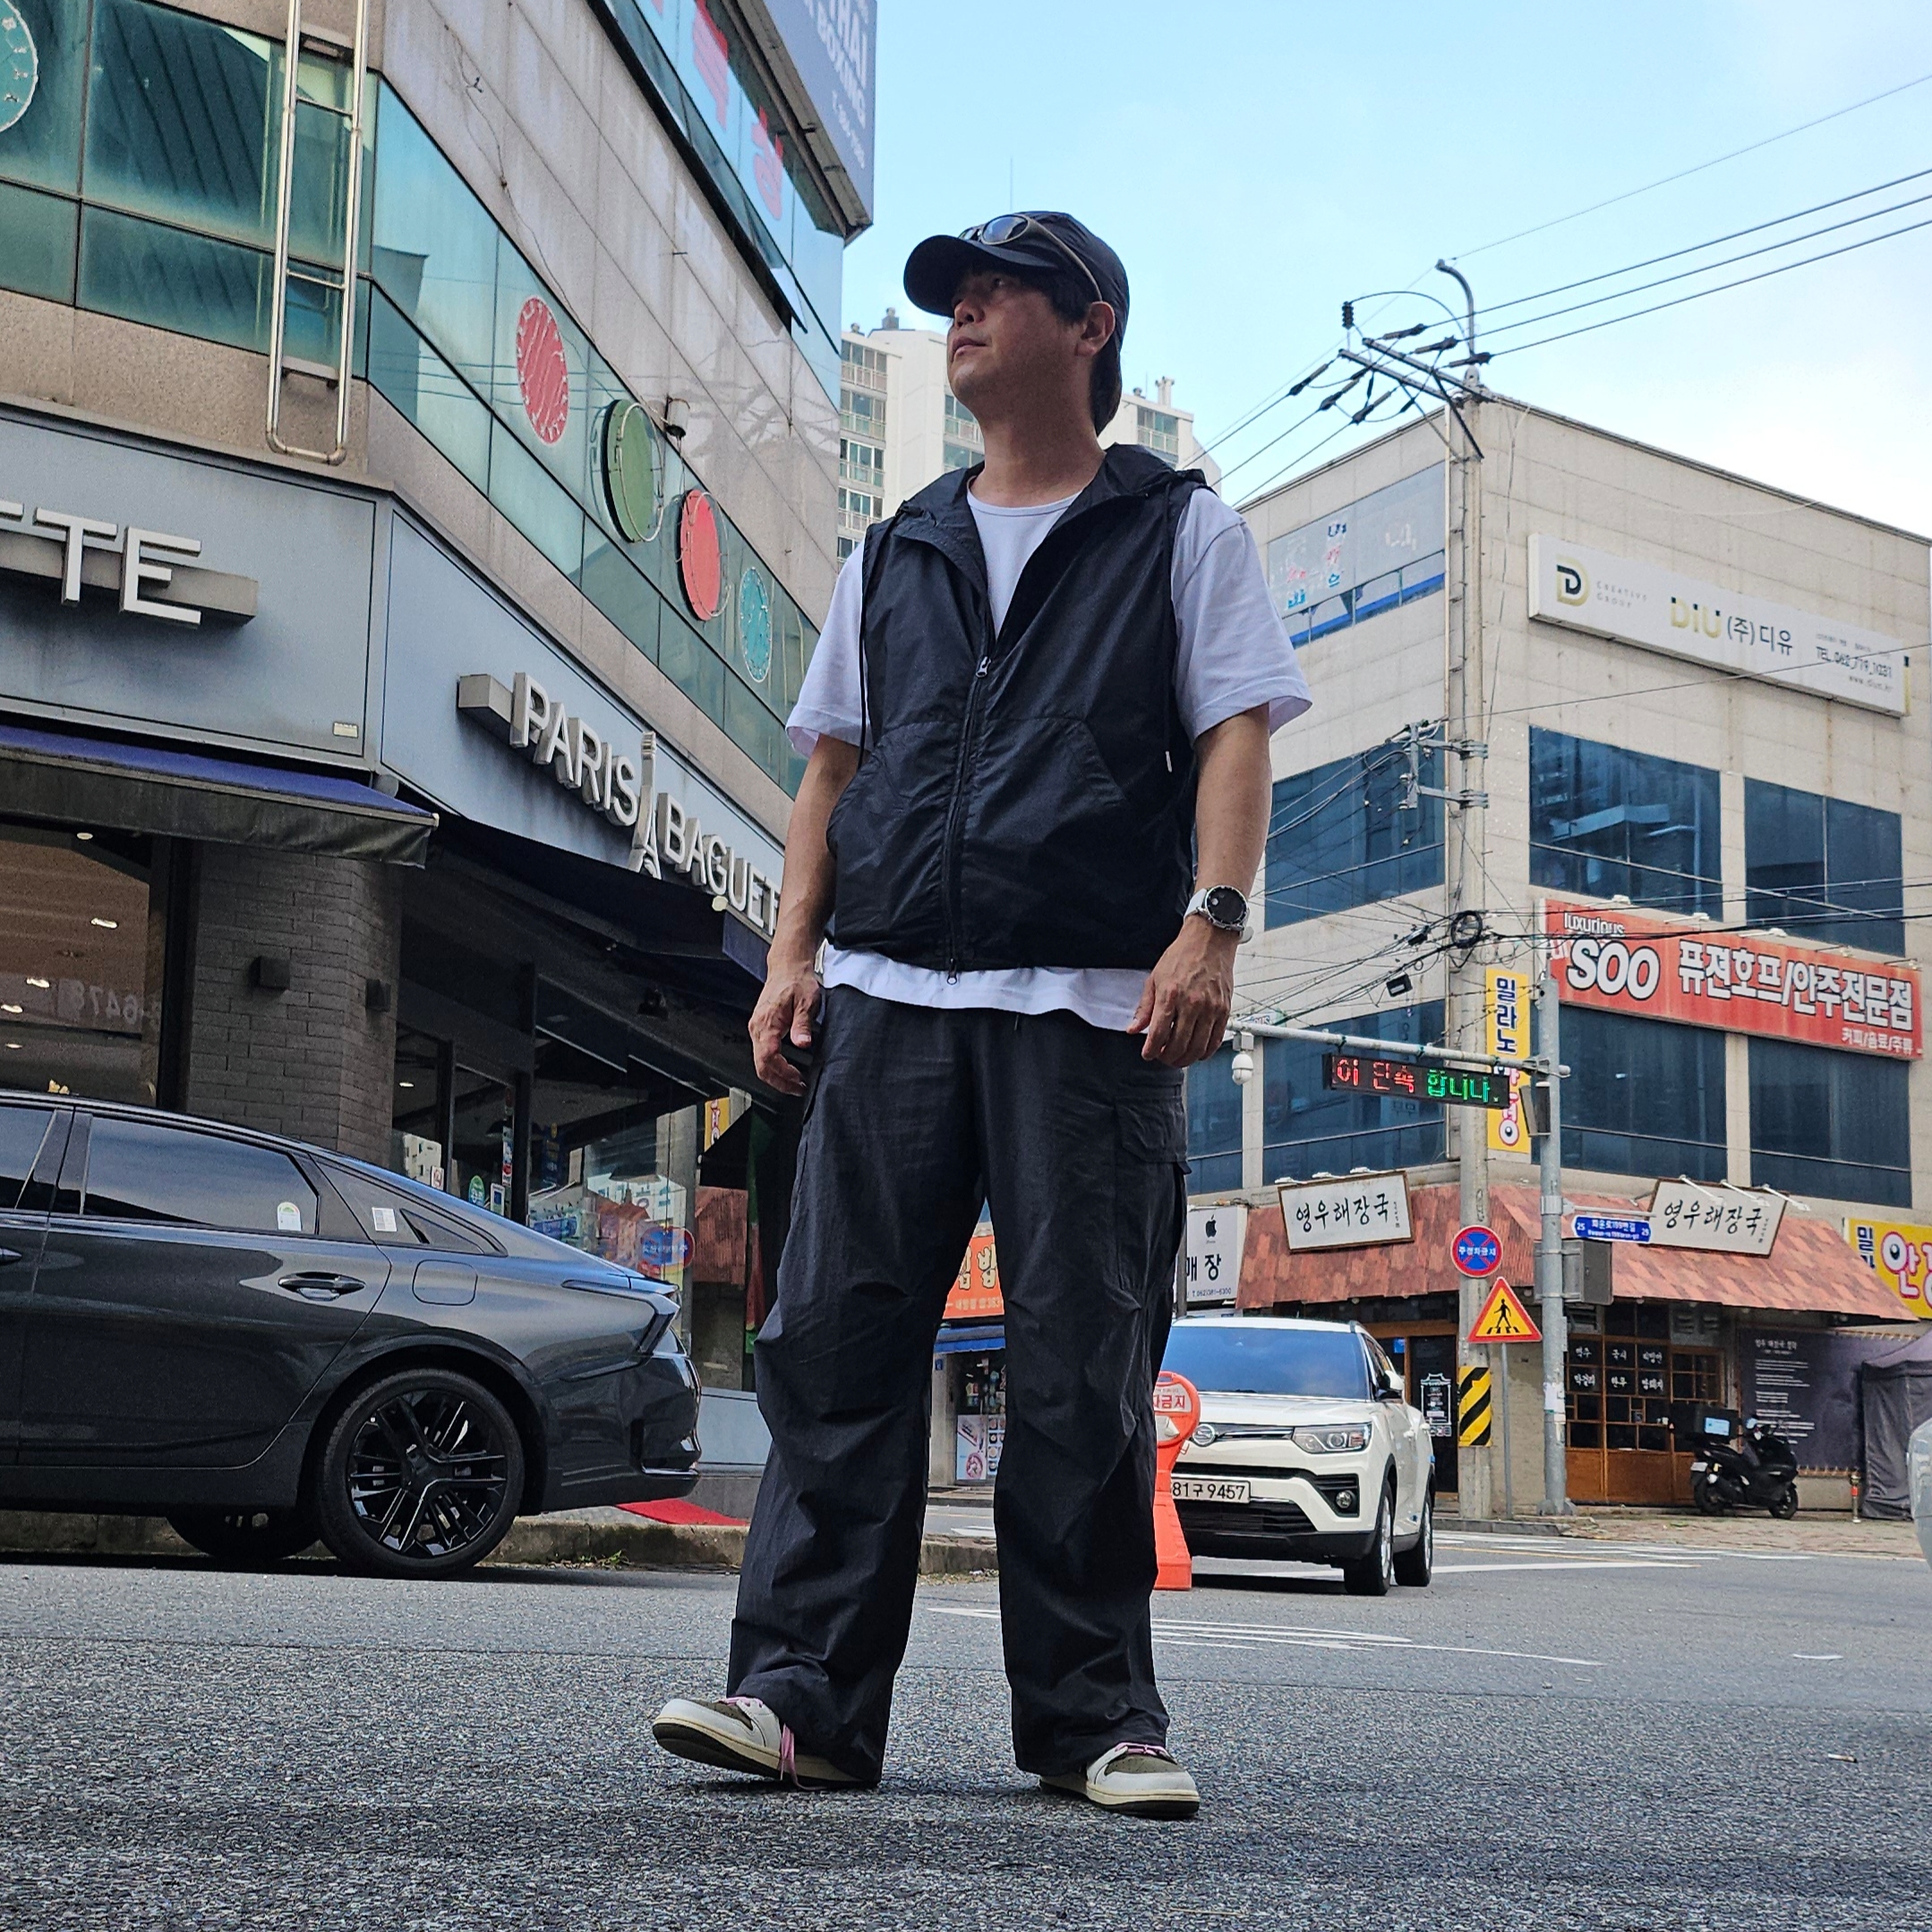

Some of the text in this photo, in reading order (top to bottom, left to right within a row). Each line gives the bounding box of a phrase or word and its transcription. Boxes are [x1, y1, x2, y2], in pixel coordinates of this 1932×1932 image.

[0, 500, 202, 628] TE
[509, 672, 638, 826] PARIS
[1563, 912, 1626, 937] luxurious
[1566, 936, 1661, 1001] SOO
[1496, 978, 1517, 1053] 밀라노
[1295, 1193, 1389, 1233] 영우해장국
[1664, 1199, 1762, 1236] 영우해장국
[1172, 1483, 1246, 1500] 81구 9457
